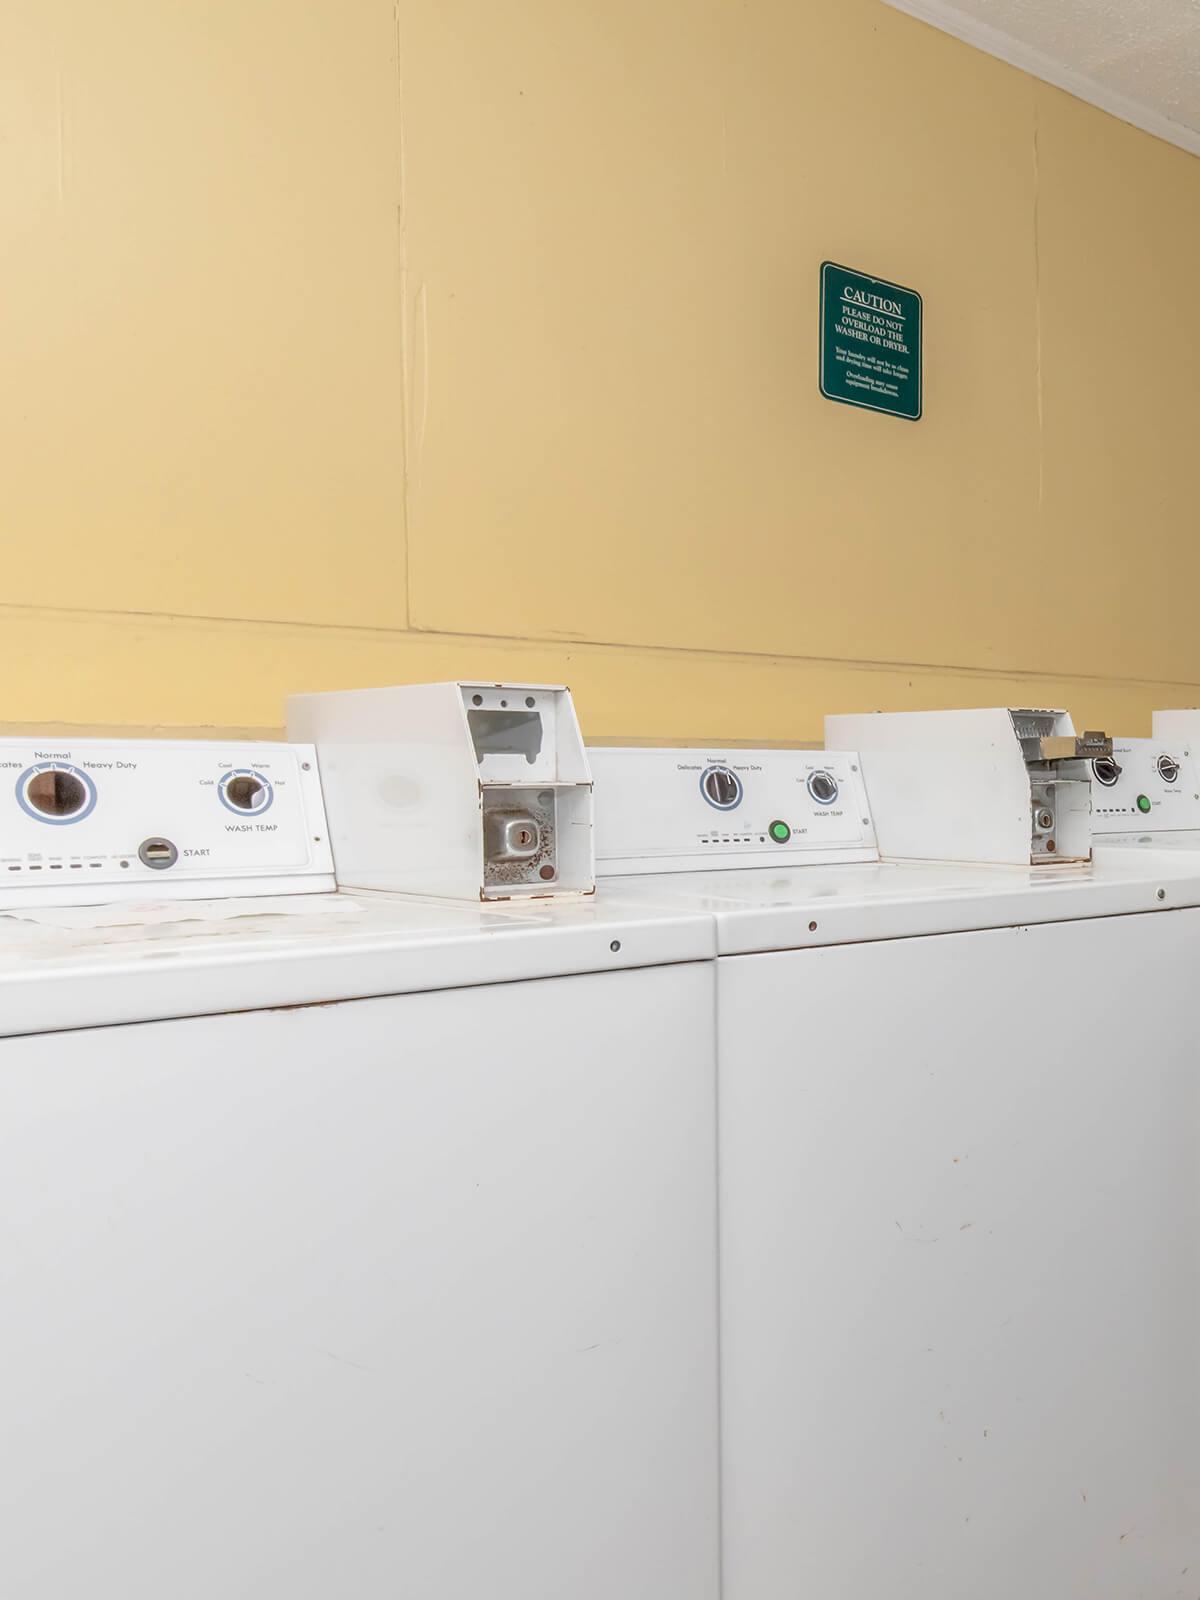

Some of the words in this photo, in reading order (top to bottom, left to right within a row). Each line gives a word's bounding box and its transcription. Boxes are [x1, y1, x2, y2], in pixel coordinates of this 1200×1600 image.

[844, 287, 901, 315] CAUTION
[842, 305, 871, 321] PLEASE
[872, 315, 885, 325] DO
[886, 320, 903, 332] NOT
[841, 316, 886, 336] OVERLOAD
[887, 329, 904, 342] THE
[835, 323, 869, 342] WASHER
[869, 335, 881, 346] OR
[883, 338, 910, 354] DRYER.
[34, 751, 71, 759] Normal
[83, 761, 113, 769] Heavy
[117, 761, 137, 769] Duty
[225, 824, 252, 832] WASH
[255, 824, 278, 832] TEMP
[183, 848, 210, 857] START
